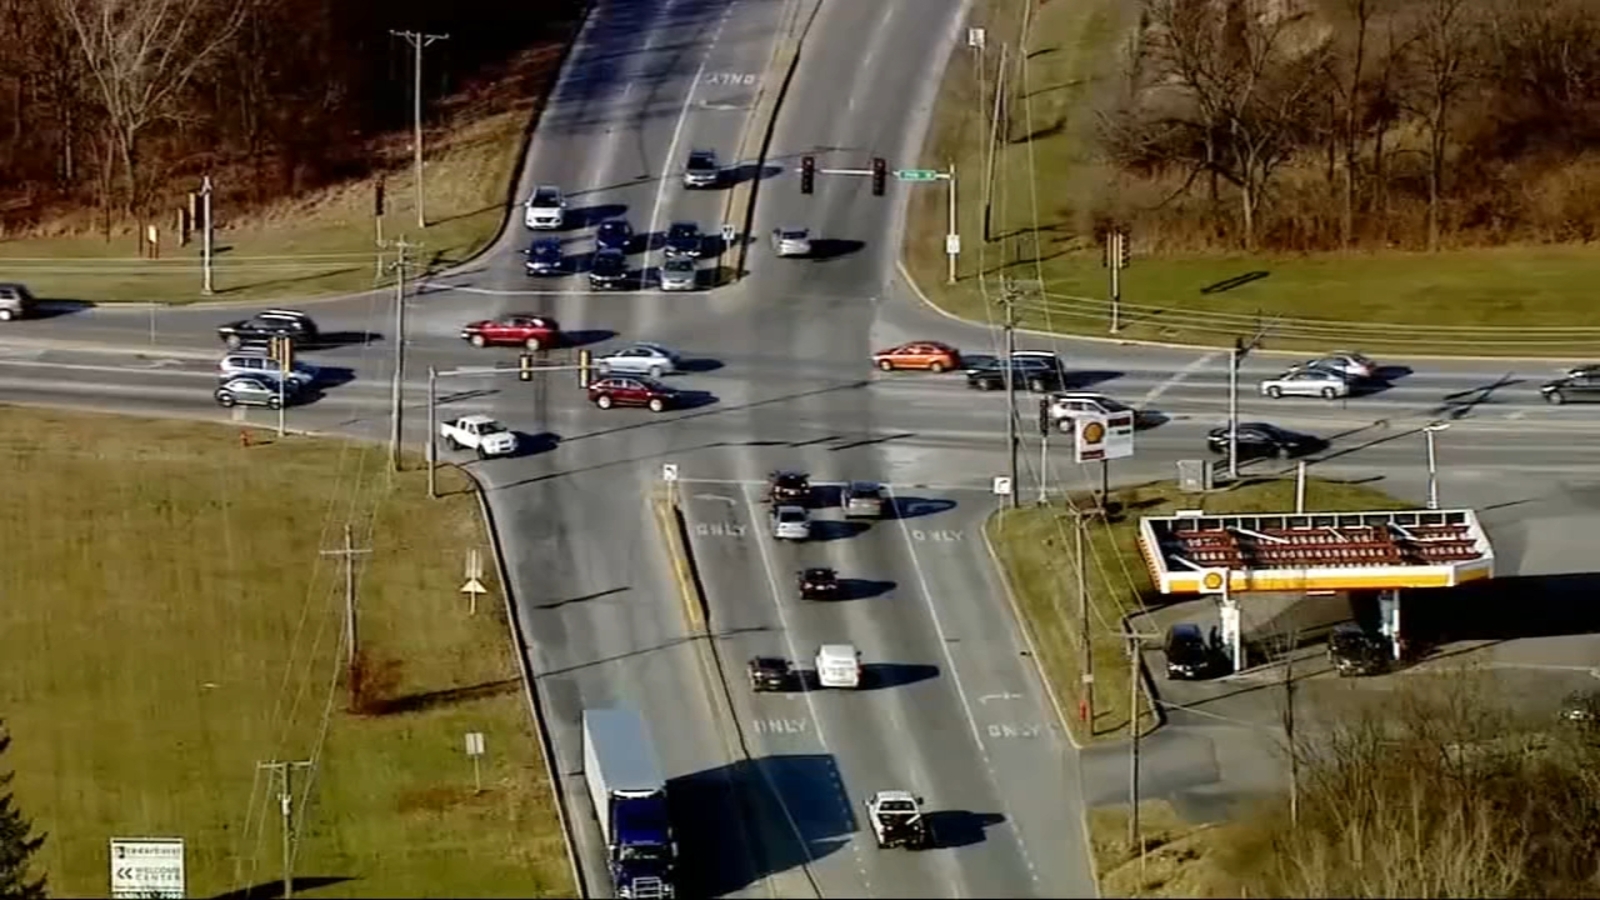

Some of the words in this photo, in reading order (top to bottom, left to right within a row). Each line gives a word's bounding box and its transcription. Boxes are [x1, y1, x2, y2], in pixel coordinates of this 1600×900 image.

[705, 73, 756, 85] ONLY
[696, 523, 747, 536] ONLY
[912, 529, 964, 541] ONLY
[752, 718, 806, 732] ONLY
[988, 723, 1040, 737] ONLY
